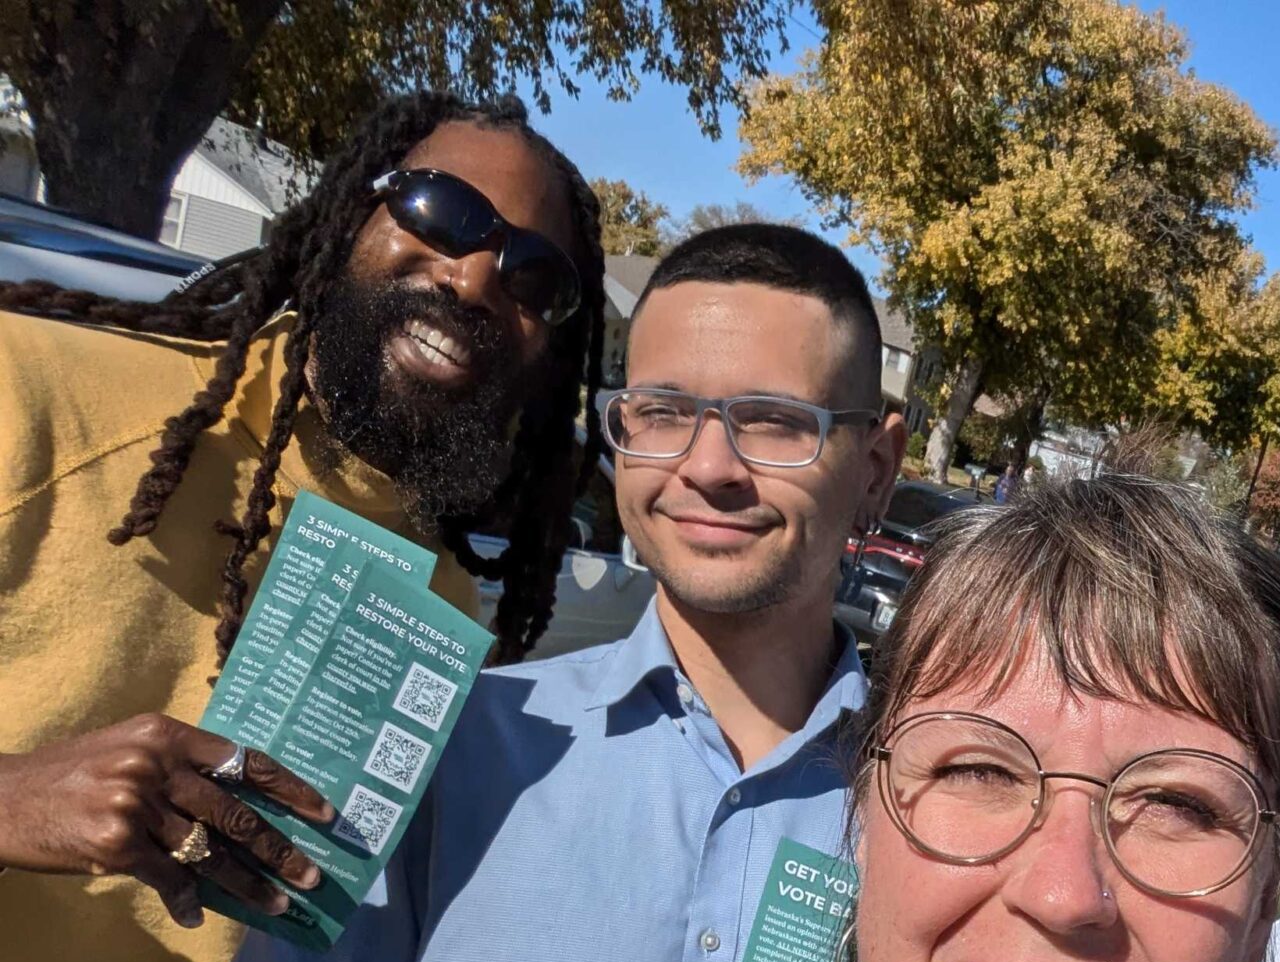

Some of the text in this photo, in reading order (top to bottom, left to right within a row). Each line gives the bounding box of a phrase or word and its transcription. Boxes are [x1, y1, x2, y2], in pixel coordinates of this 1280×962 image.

[297, 525, 336, 549] RESTO
[306, 515, 315, 525] 3
[360, 540, 395, 564] STEPS
[396, 557, 412, 572] TO
[356, 604, 467, 673] RESTORE YOUR VOTE
[367, 592, 465, 655] 3 SIMPLE STEPS TO
[785, 860, 820, 882] GET
[779, 881, 826, 911] VOTE
